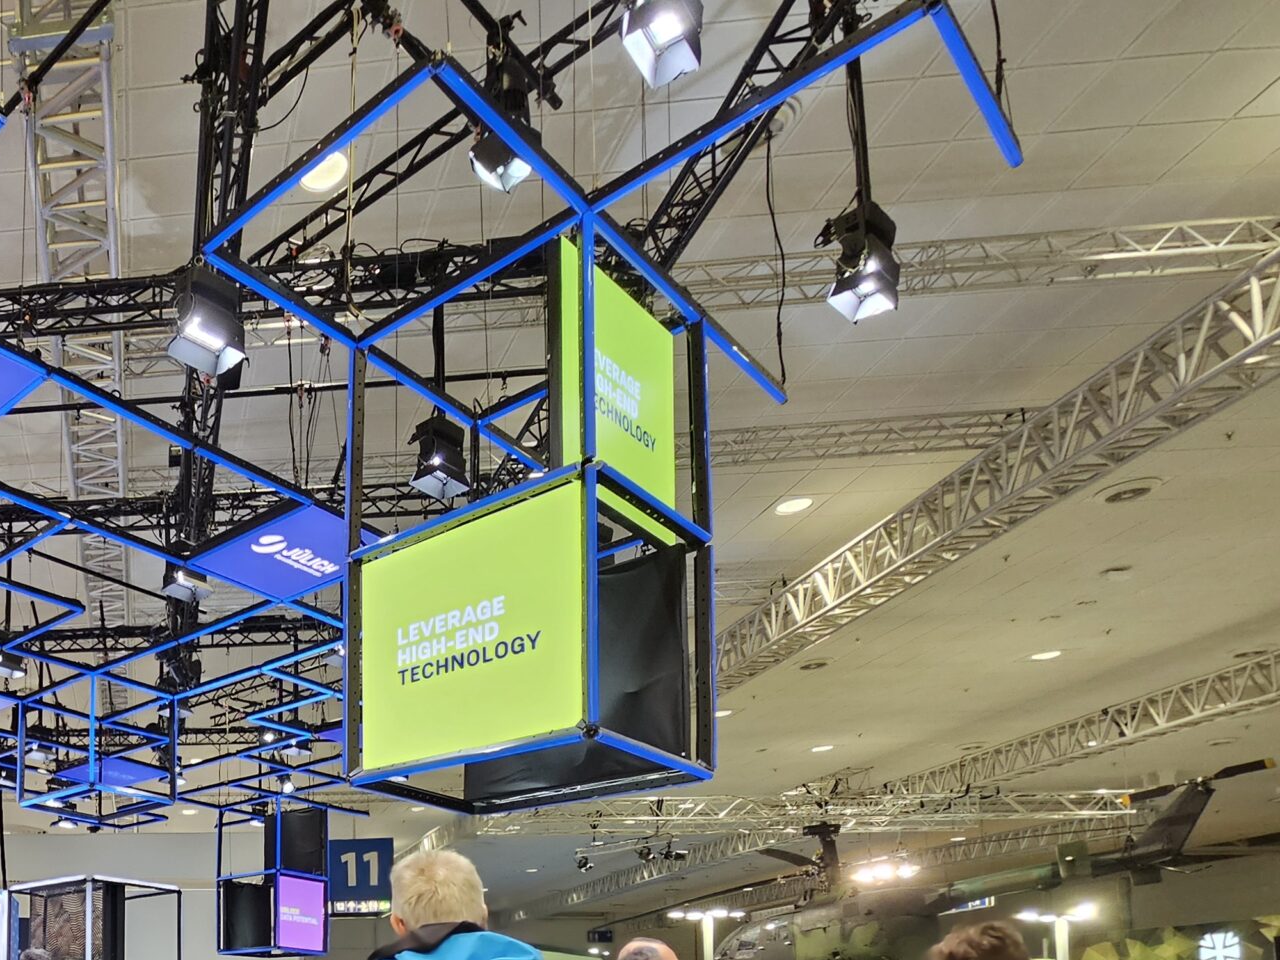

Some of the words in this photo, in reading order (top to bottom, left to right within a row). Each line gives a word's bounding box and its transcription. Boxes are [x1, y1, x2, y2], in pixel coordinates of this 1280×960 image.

[594, 347, 641, 401] VERAGE
[594, 373, 639, 420] GH-END
[594, 391, 656, 452] CHNOLOGY
[281, 547, 340, 575] JÜLICH
[397, 595, 506, 645] LEVERAGE
[397, 621, 500, 667] HIGH-END
[398, 630, 541, 685] TECHNOLOGY
[341, 851, 378, 887] 11
